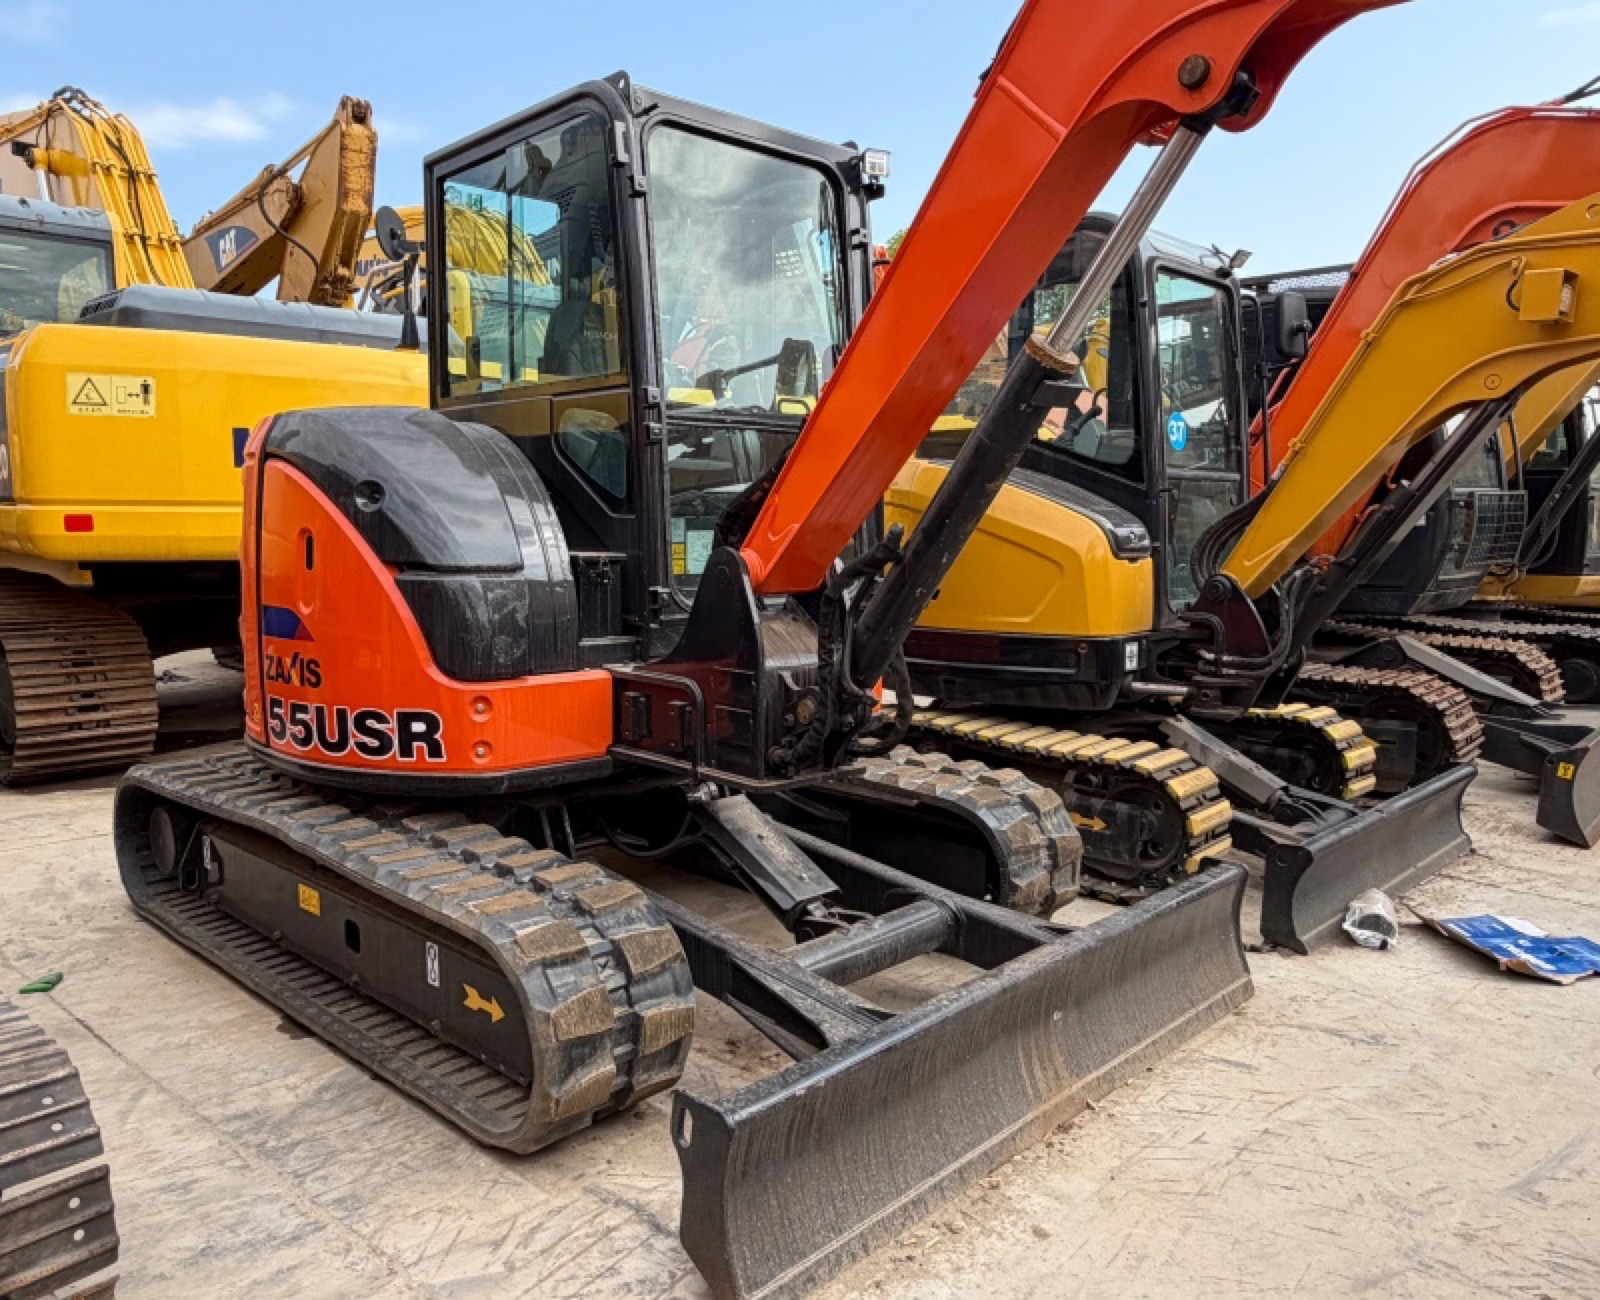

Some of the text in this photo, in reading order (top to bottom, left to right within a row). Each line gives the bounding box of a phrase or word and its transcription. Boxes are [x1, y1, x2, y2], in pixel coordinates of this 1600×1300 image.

[219, 228, 237, 268] CAT
[1168, 420, 1185, 443] 37
[265, 652, 323, 689] ZAXIS
[267, 695, 447, 762] 55USR
